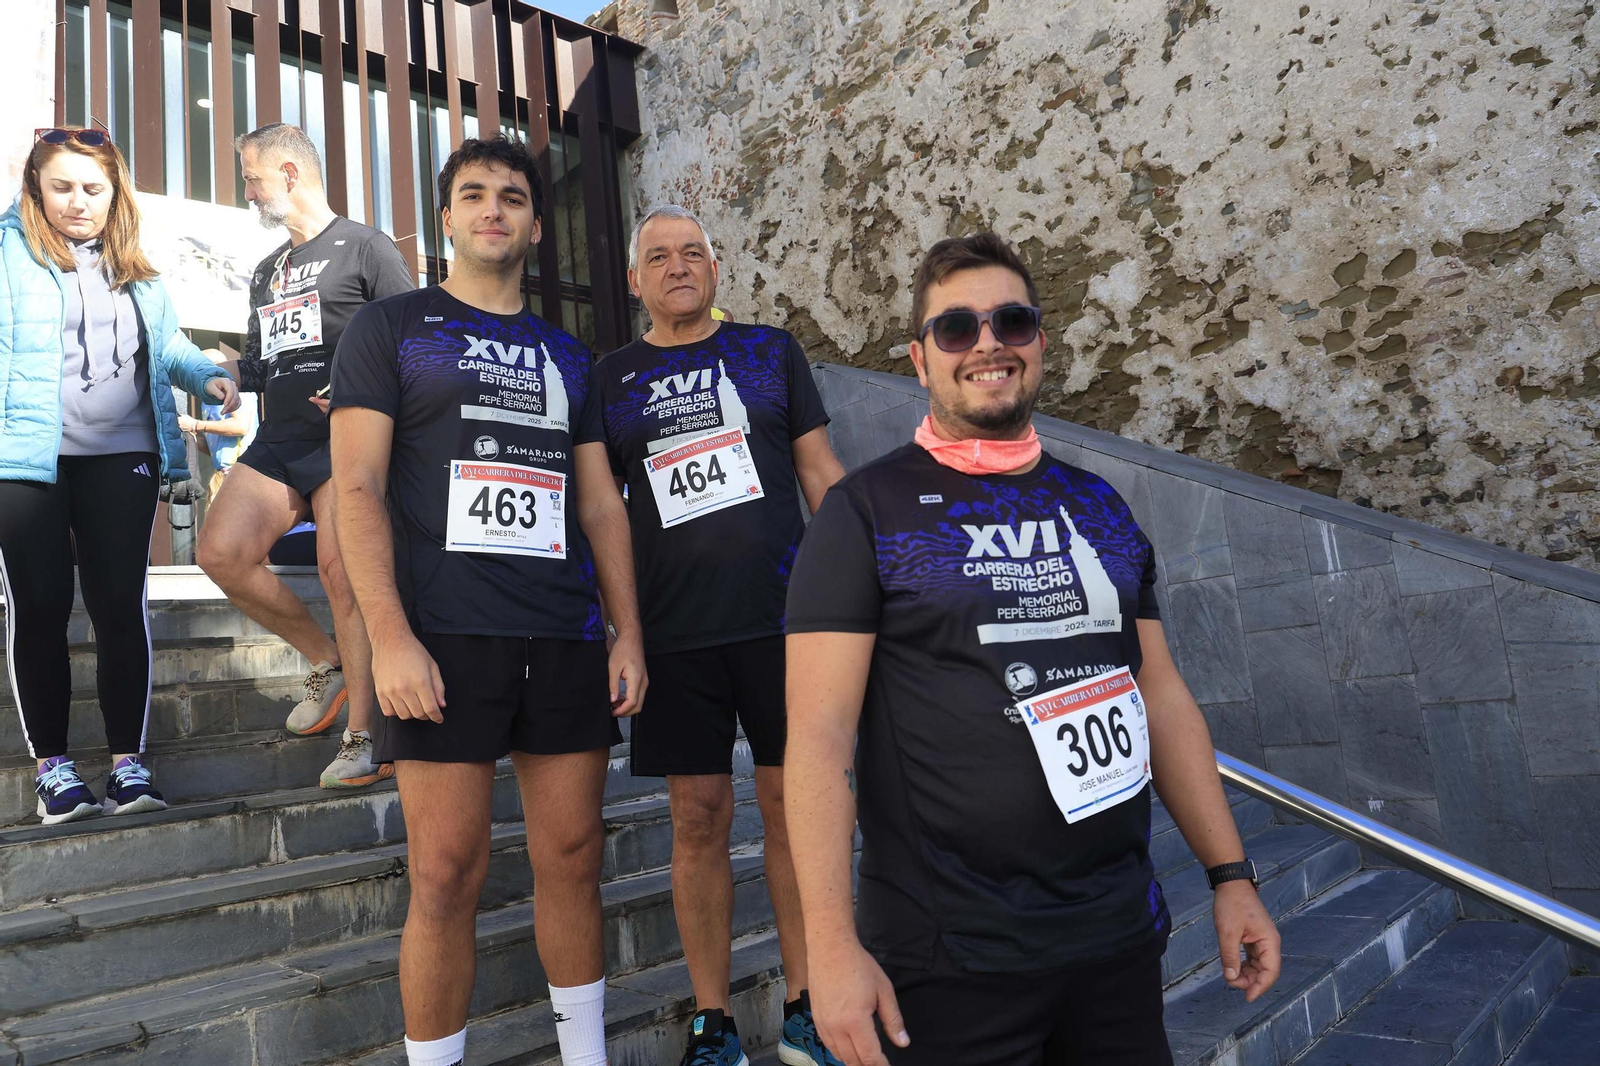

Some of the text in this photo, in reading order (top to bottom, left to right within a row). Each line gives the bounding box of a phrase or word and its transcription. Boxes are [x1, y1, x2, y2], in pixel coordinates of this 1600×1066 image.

[269, 311, 302, 340] 445
[463, 334, 537, 369] XVI
[458, 359, 541, 382] CARRERA DEL
[479, 371, 541, 393] ESTRECHO
[646, 368, 712, 404] XVI
[479, 394, 543, 413] PEPE SERRANO
[499, 389, 542, 405] MEMORIAL
[642, 390, 714, 416] CARRERA DEL
[658, 399, 716, 419] ESTRECHO
[676, 410, 718, 425] MEMORIAL
[527, 417, 542, 425] 2025
[660, 417, 719, 436] PEPE SERRANO
[664, 447, 693, 464] CARRERA
[692, 442, 706, 452] DEL
[706, 432, 741, 447] ESTRECHO
[478, 467, 515, 479] CARRERA
[515, 472, 530, 481] DEL
[529, 475, 563, 487] ESTRECHO
[669, 454, 727, 499] 464
[468, 486, 537, 530] 463
[684, 491, 715, 507] FERNANDO
[485, 529, 517, 538] ERNESTO
[960, 519, 1060, 558] XVI
[962, 557, 1069, 577] CARRERA DEL
[991, 570, 1074, 592] ESTRECHO
[997, 599, 1083, 620] PEPE SERRANO
[1018, 589, 1080, 608] MEMORIAL
[1014, 619, 1116, 636] 7 DICIEMBRE 2025 TARIFA
[1053, 688, 1092, 710] CARRERA
[1090, 684, 1106, 698] DEL
[1056, 705, 1133, 777] 306
[1078, 778, 1097, 793] JOSE
[1097, 768, 1125, 785] MANUEL
